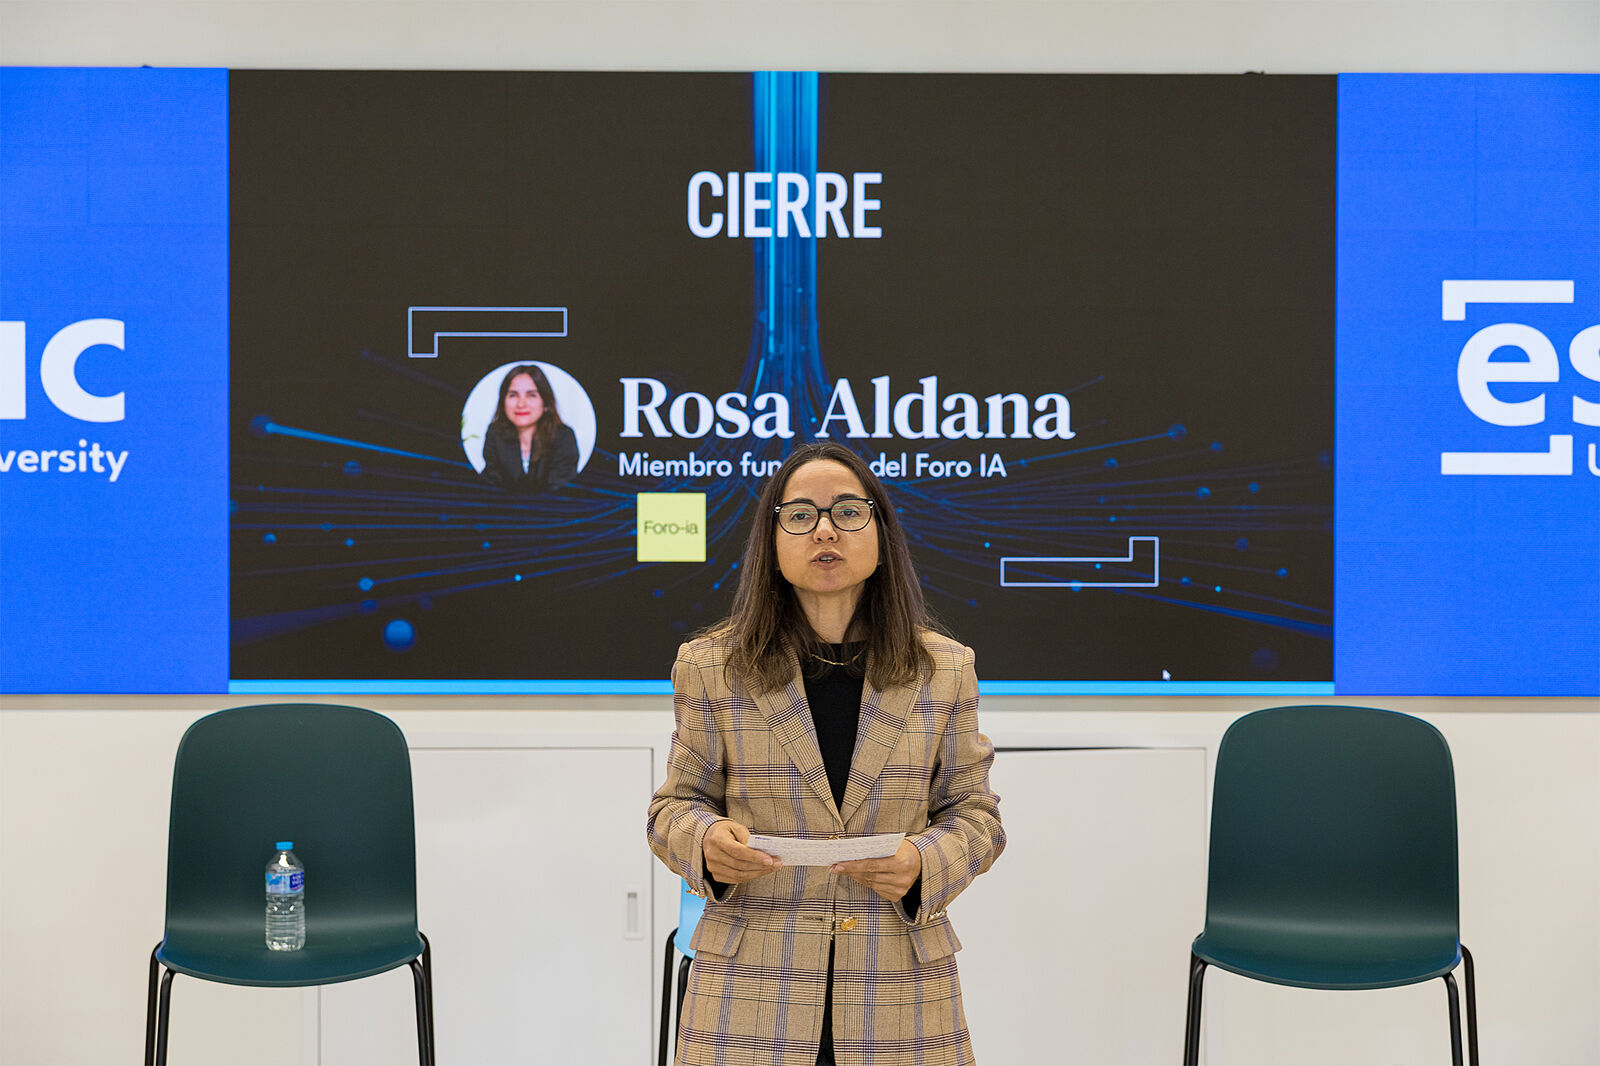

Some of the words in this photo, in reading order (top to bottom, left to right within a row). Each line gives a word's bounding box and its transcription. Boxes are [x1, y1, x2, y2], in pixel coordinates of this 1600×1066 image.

[687, 171, 882, 238] CIERRE
[619, 377, 795, 440] Rosa
[814, 375, 1076, 440] Aldana
[618, 452, 733, 478] Miembro
[869, 452, 907, 478] del
[915, 453, 972, 478] Foro
[979, 454, 1008, 477] IA
[643, 519, 699, 535] Foro-ia
